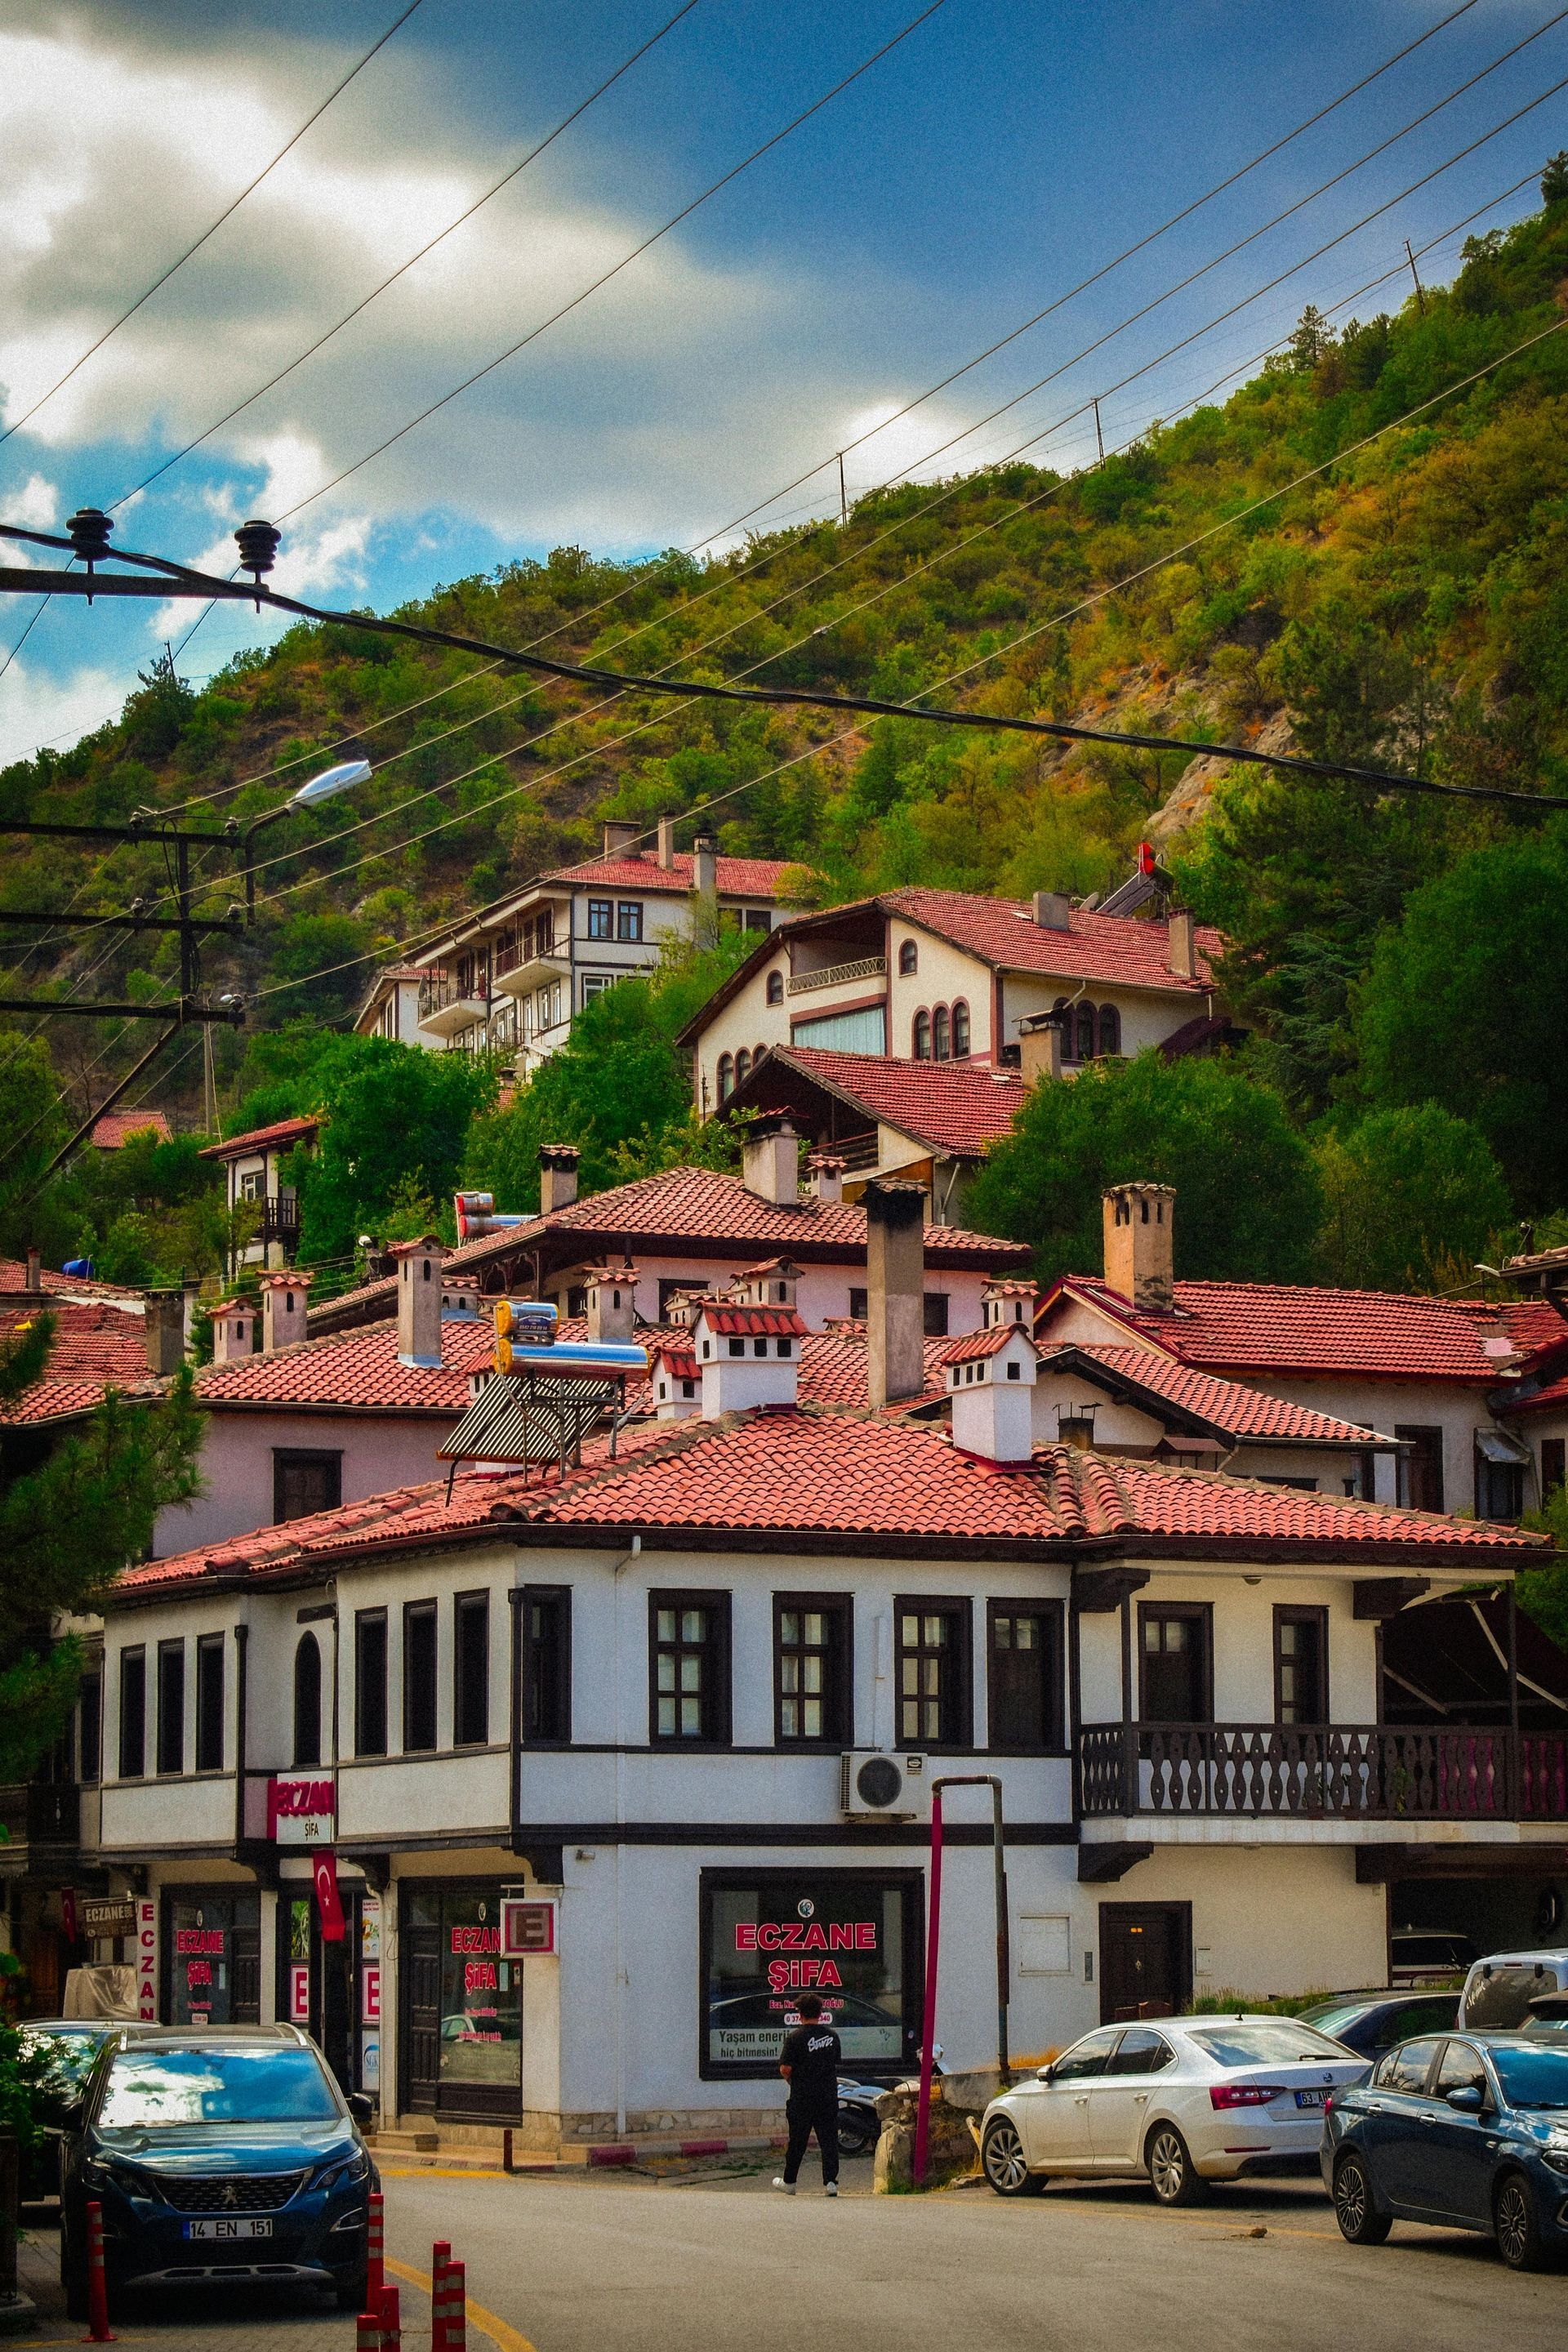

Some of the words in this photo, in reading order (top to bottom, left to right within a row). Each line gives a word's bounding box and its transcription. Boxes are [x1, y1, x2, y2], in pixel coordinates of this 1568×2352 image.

[278, 1781, 335, 1817] ECZAN
[85, 1905, 124, 1922] ECZANE
[452, 1927, 501, 1953] ECZAN
[516, 1910, 545, 1945] E
[736, 1923, 876, 1950] ECZANE
[176, 1930, 224, 1953] ECZANE
[140, 1904, 155, 2020] ECZAN
[296, 1971, 308, 2014] E
[368, 1971, 380, 2016] E
[719, 2030, 755, 2045] Yaşam
[721, 2047, 734, 2059] hiç
[737, 2047, 778, 2057] bitmesin!
[1301, 2092, 1313, 2104] 63
[190, 2222, 206, 2238] 14
[216, 2221, 238, 2237] EN
[250, 2220, 271, 2236] 151
